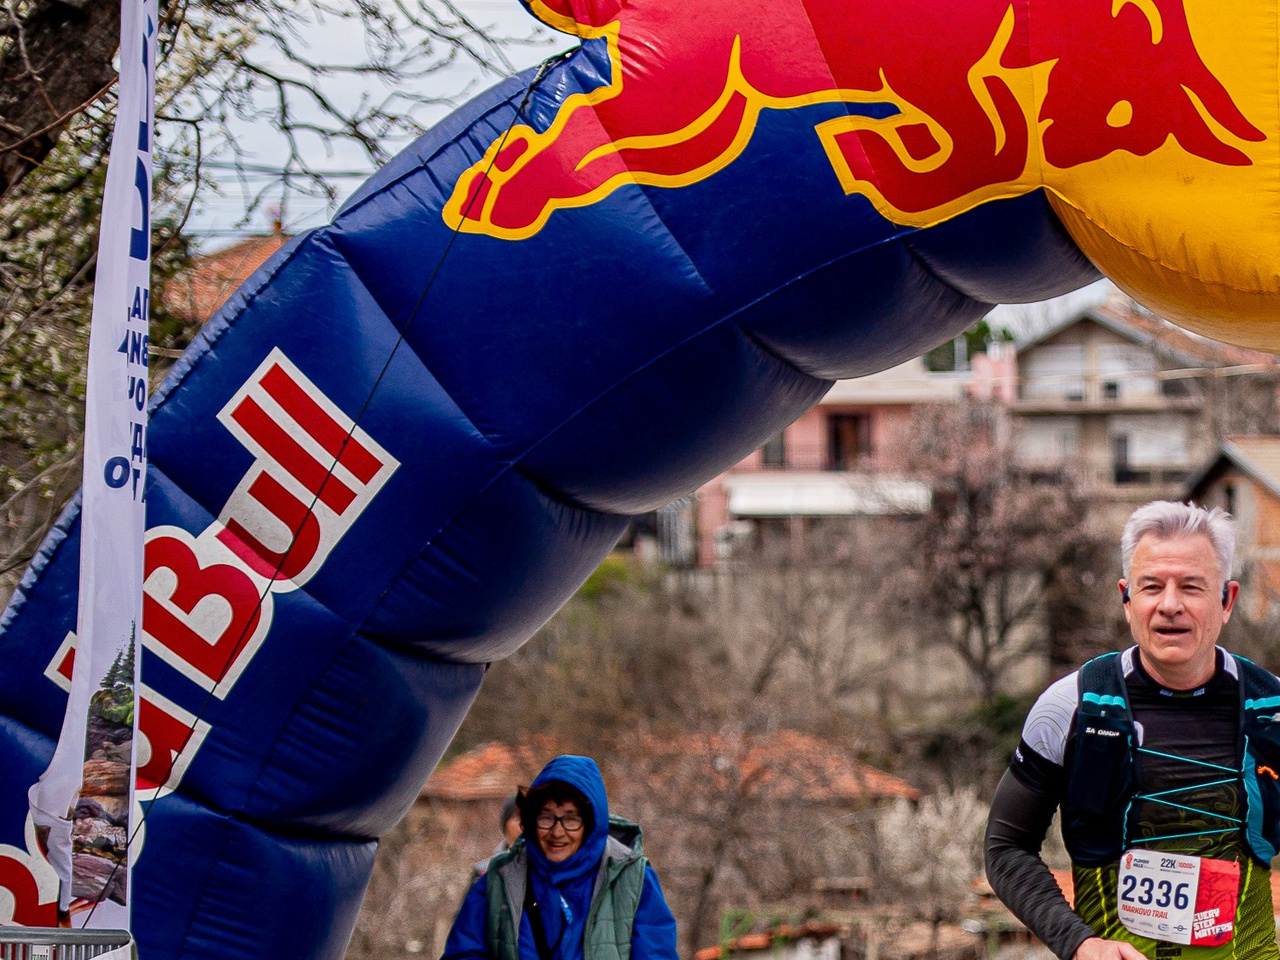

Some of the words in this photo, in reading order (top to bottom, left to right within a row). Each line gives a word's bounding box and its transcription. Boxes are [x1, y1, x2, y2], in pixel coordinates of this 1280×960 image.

[143, 347, 400, 700] Bull
[1160, 857, 1176, 869] 22K
[1121, 875, 1189, 910] 2336
[1121, 904, 1151, 916] MARKOVO
[1152, 909, 1169, 920] TRAIL
[1193, 918, 1215, 931] STEP
